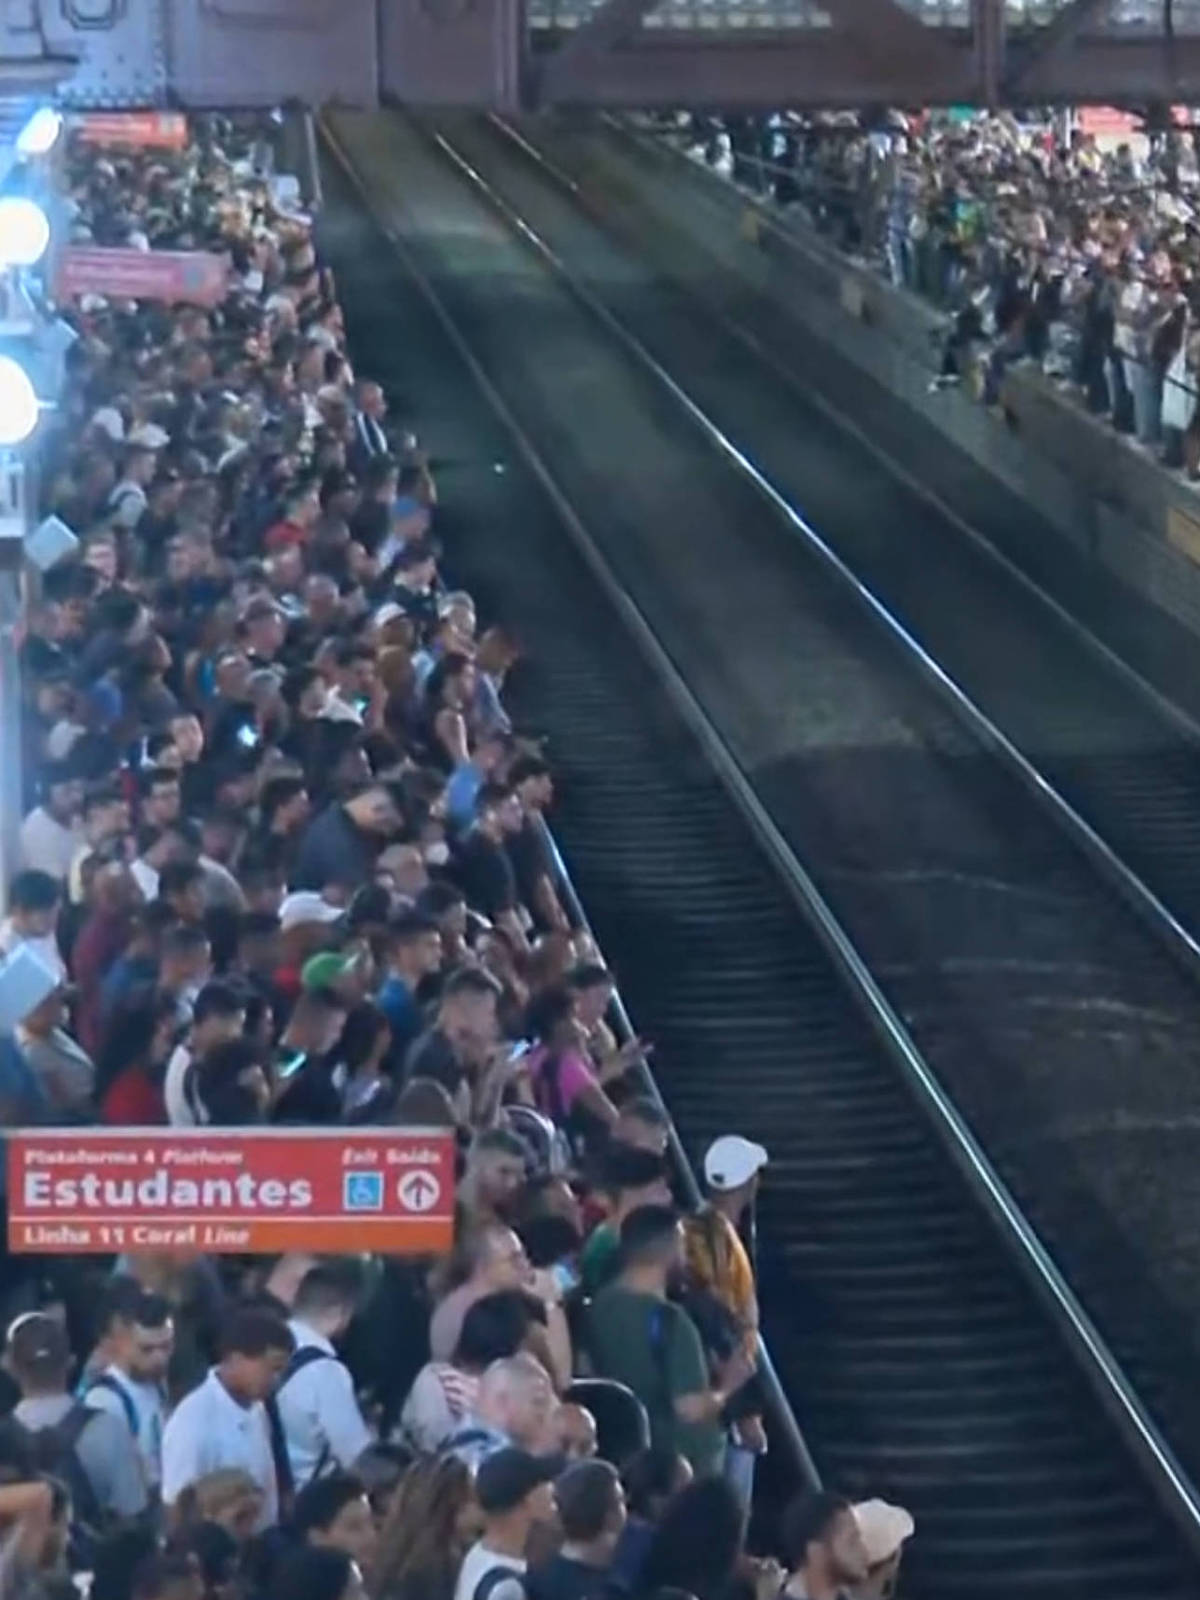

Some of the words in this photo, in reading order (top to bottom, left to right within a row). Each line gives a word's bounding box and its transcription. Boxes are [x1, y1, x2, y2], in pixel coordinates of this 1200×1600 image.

[25, 1148, 138, 1165] Plataforma
[162, 1148, 243, 1165] Platform
[24, 1171, 313, 1208] Estudantes
[24, 1225, 91, 1244] Linha
[99, 1226, 124, 1244] 11
[132, 1225, 197, 1244] Coral
[204, 1225, 251, 1244] Line
